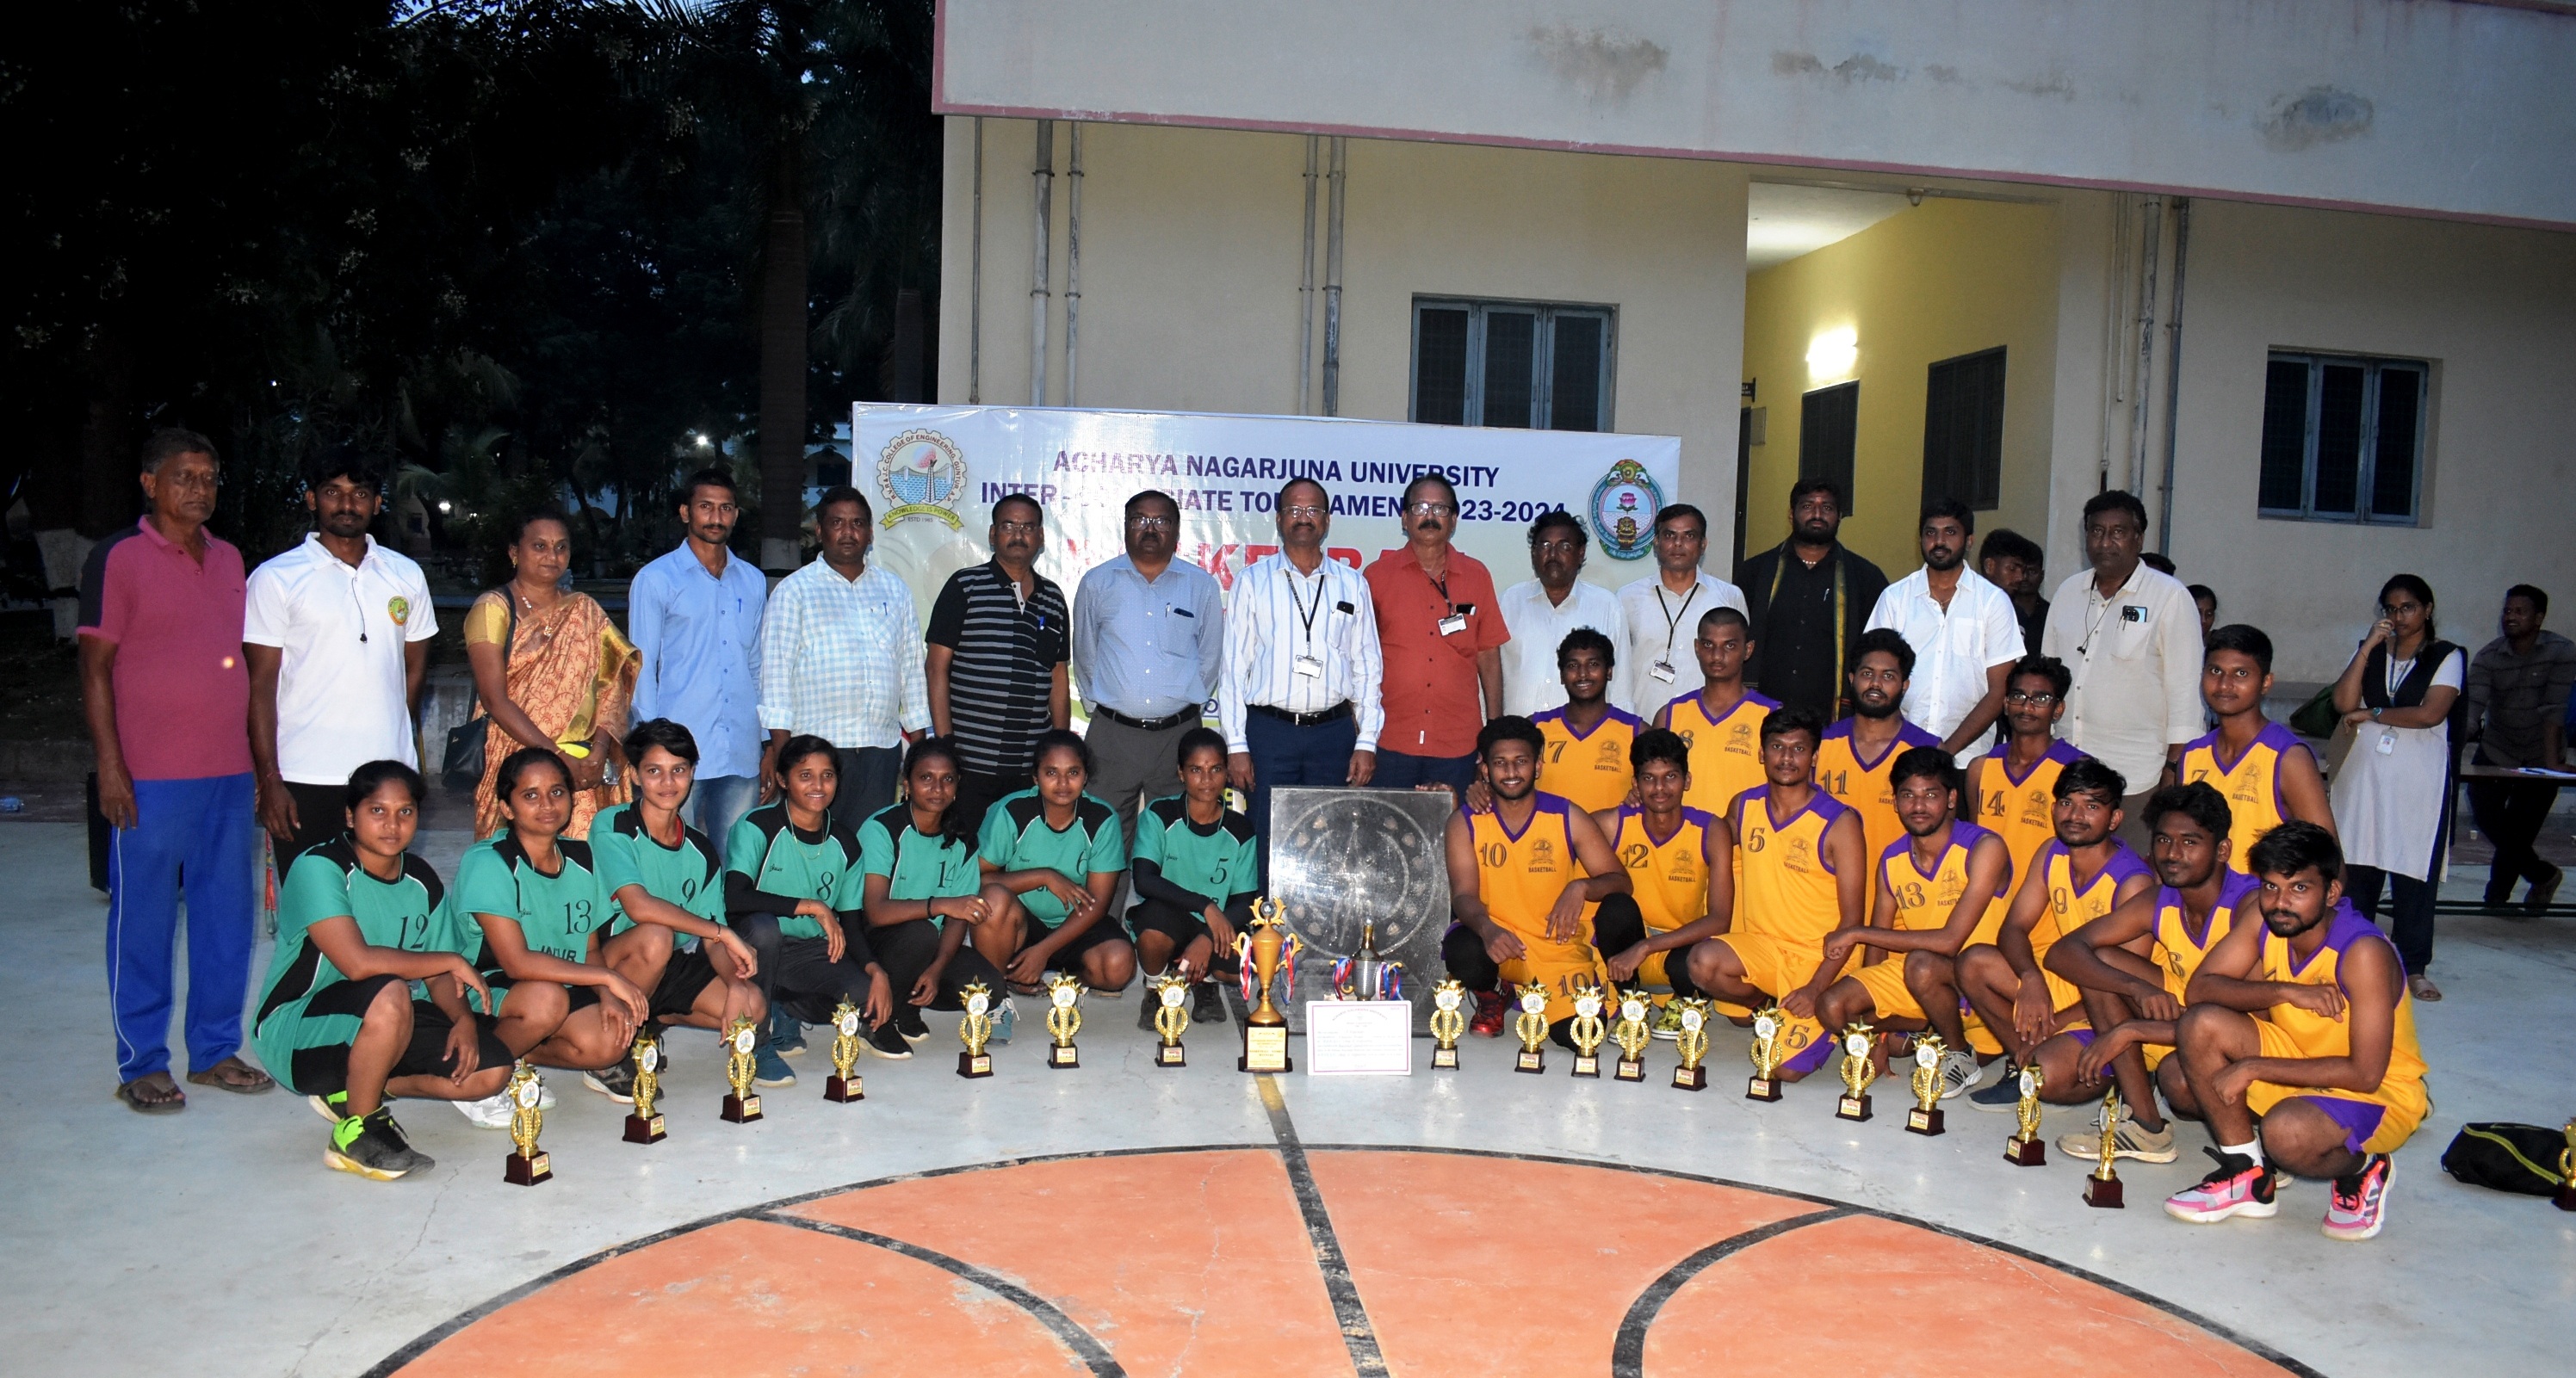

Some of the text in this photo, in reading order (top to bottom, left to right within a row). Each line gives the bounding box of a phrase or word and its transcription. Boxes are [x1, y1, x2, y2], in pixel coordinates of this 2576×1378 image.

[884, 439, 906, 464] COLLEGE
[1052, 450, 1500, 488] ACHARYA NAGARJUNA UNIVERSITY
[888, 504, 926, 519] KNOWLEDGE
[933, 507, 956, 521] POWER
[1724, 746, 1752, 757] BASKETBALL
[1594, 764, 1622, 773] BASKETBALL
[1820, 769, 1849, 794] 11
[2021, 817, 2047, 829] BASKETBALL
[1747, 826, 1766, 853] 5
[1479, 842, 1508, 868] 10
[1621, 843, 1649, 869] 12
[1210, 857, 1229, 885] 5
[1668, 874, 1696, 883] BASKETBALL
[816, 871, 834, 902] 8
[1895, 881, 1926, 910] 13
[2053, 887, 2068, 915] 9
[563, 899, 591, 936] 13
[397, 913, 429, 949] 12
[1784, 1023, 1810, 1049] 5
